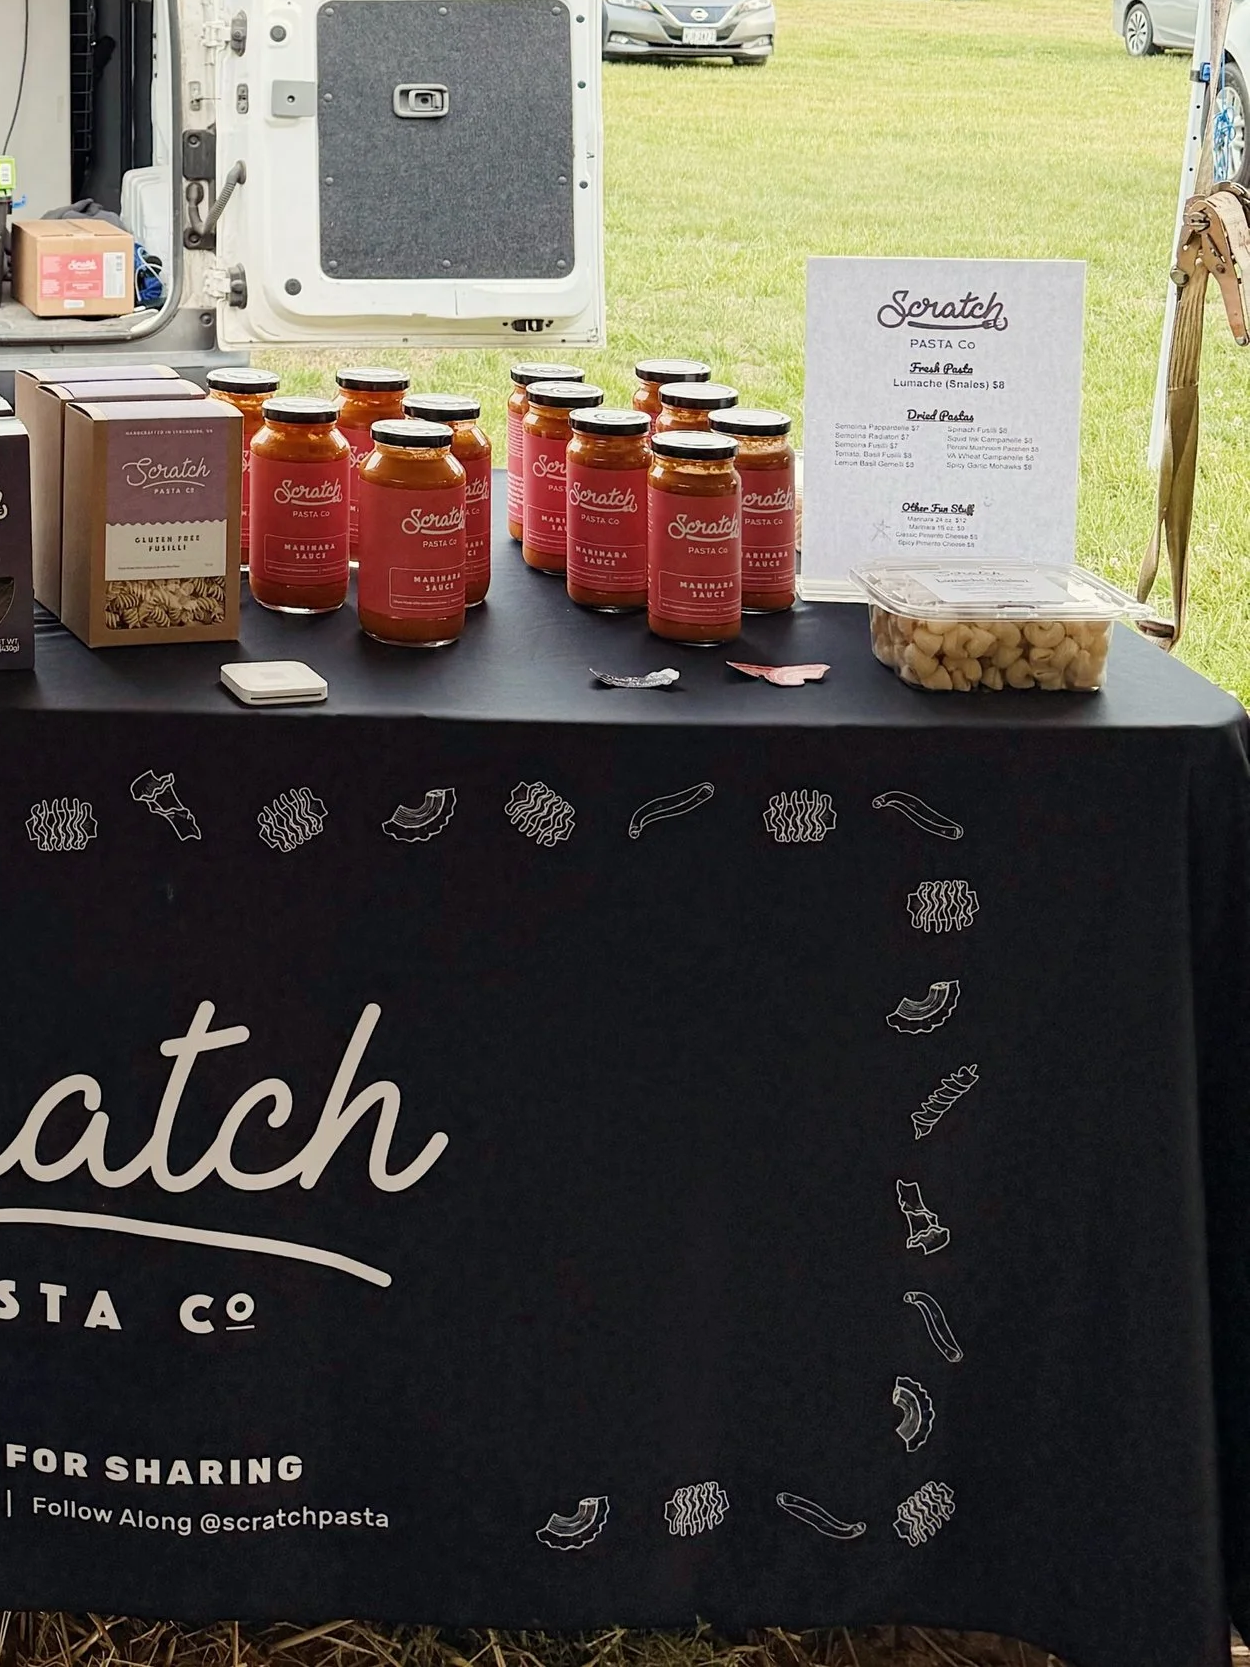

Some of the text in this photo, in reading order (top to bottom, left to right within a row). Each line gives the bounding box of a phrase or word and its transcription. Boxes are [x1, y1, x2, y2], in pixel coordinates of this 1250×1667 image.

[877, 289, 1008, 331] Scratch
[910, 339, 976, 350] PASTA Co
[909, 361, 974, 374] Fresh Pasta
[893, 378, 943, 388] Lumache
[992, 381, 1005, 389] $8
[907, 409, 974, 422] Dried Pastas
[121, 457, 211, 487] Scratch
[154, 487, 181, 495] PASTA
[273, 478, 343, 505] Scratch
[569, 482, 638, 512] Scratch
[741, 485, 795, 513] cratch
[292, 510, 319, 518] PASTA
[901, 502, 975, 516] Other Fun Stuff
[580, 514, 606, 524] PASTA
[744, 518, 772, 526] PASTA
[134, 534, 200, 544] GLUTEN FREE
[422, 540, 448, 548] PASTA
[148, 544, 186, 552] FUSILLI
[284, 543, 335, 551] MARINARA
[575, 545, 628, 559] MARINARA
[688, 547, 716, 555] PASTA
[741, 551, 789, 559] ARINARA
[584, 556, 616, 566] SAUCE
[413, 573, 461, 583] MARINARA
[680, 581, 734, 589] MARINARA
[6, 1443, 88, 1478] FOR
[104, 1455, 303, 1485] SHARING
[33, 1496, 113, 1524] Follow
[119, 1508, 192, 1536] Along
[200, 1505, 389, 1534] @scratchpasta
